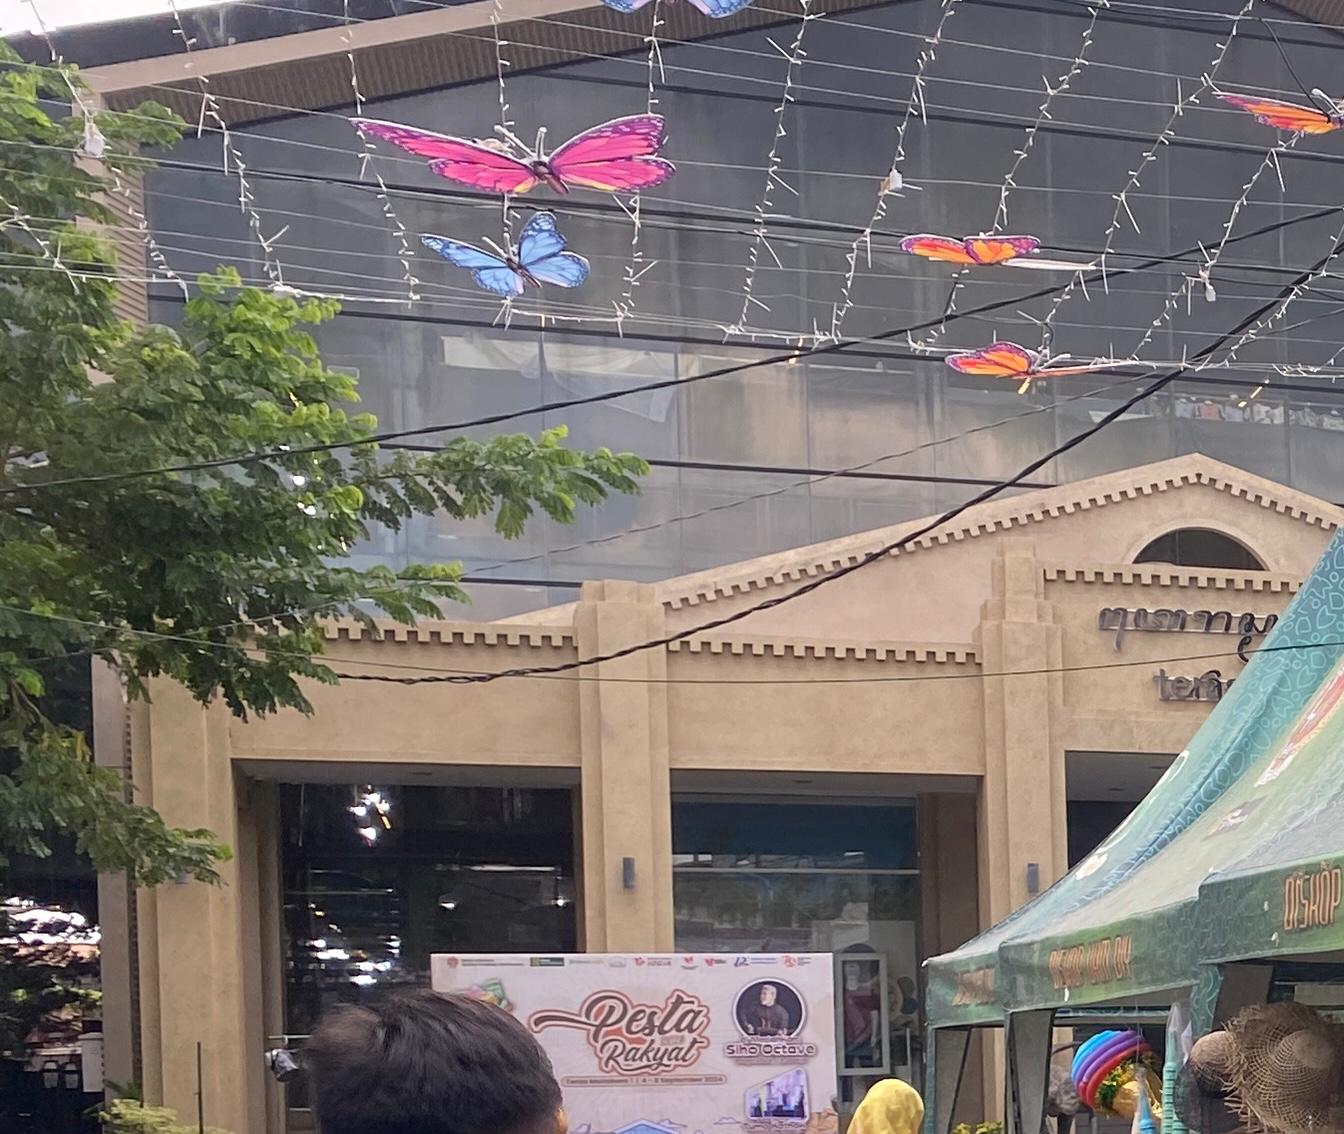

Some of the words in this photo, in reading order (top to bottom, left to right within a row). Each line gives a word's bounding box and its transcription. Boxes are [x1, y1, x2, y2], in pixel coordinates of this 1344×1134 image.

[1283, 864, 1342, 931] DISKOP
[583, 991, 708, 1038] Pesta
[602, 1038, 703, 1070] Rakyat
[762, 1043, 815, 1055] Octave
